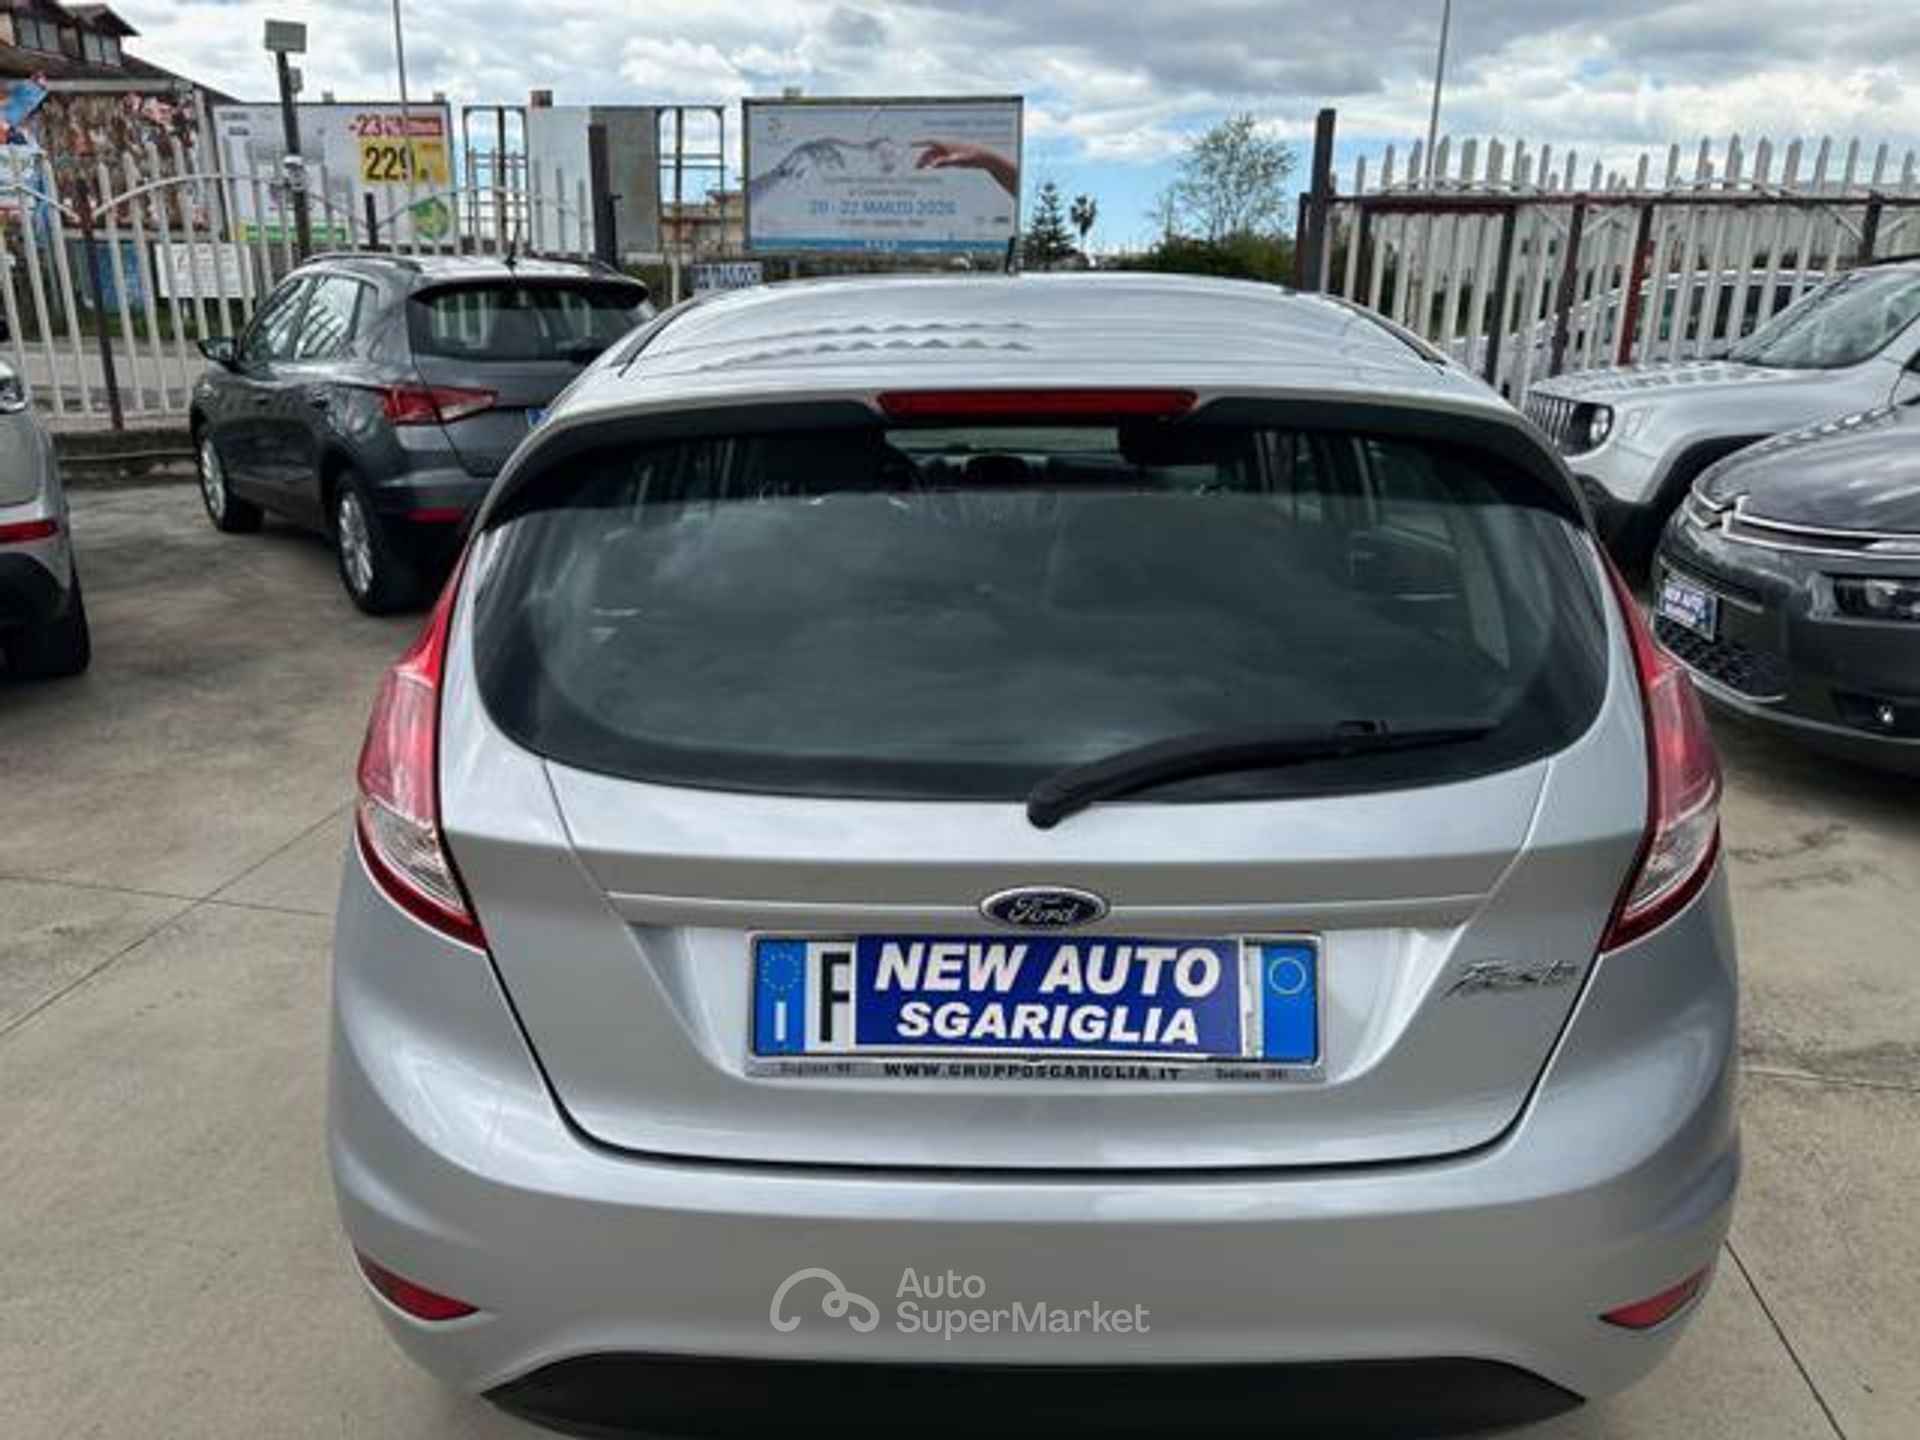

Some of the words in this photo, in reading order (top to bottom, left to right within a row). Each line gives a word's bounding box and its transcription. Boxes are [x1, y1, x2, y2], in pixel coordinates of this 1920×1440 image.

[1007, 896, 1080, 926] Ford
[874, 943, 1023, 993] NEW
[1039, 945, 1221, 999] AUTO
[897, 1001, 1199, 1045] SGARIGLIA
[884, 1062, 1181, 1080] WWW.GRUPPOSGARIGLIA.IT
